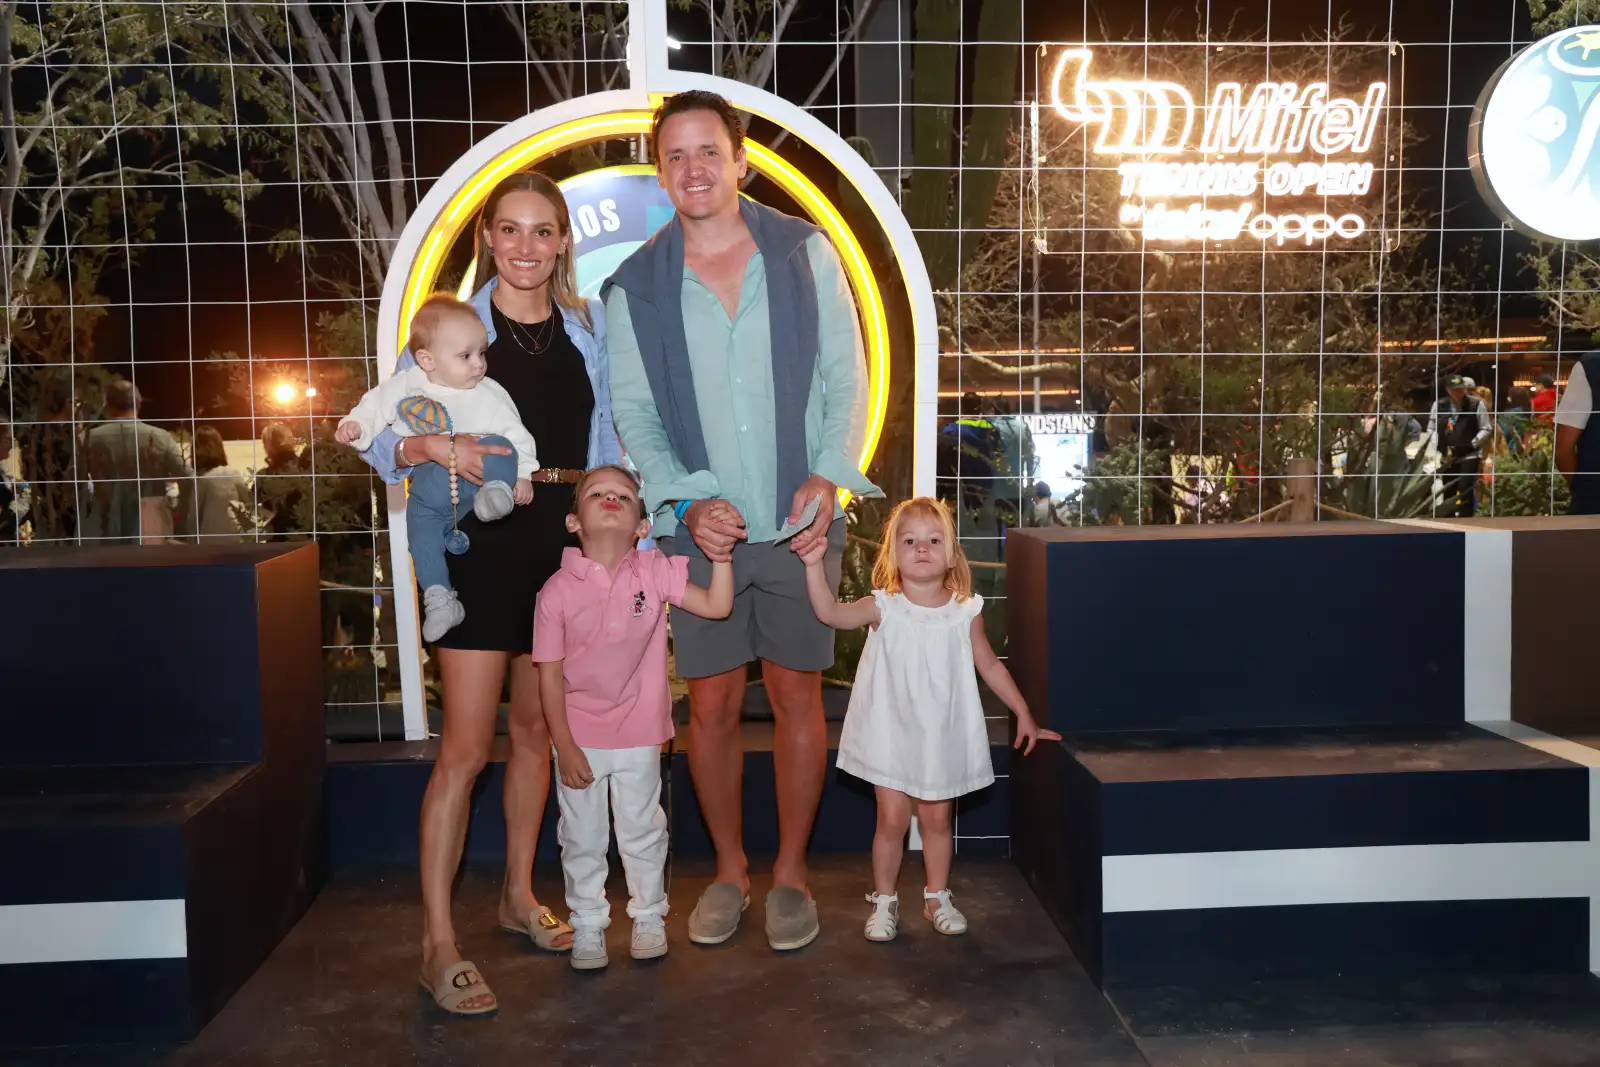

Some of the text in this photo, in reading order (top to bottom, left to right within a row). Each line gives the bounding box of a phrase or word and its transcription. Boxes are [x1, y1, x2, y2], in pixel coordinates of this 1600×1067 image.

[1202, 82, 1386, 154] Mifel
[1264, 162, 1374, 196] OPEN
[1250, 213, 1366, 246] oppo
